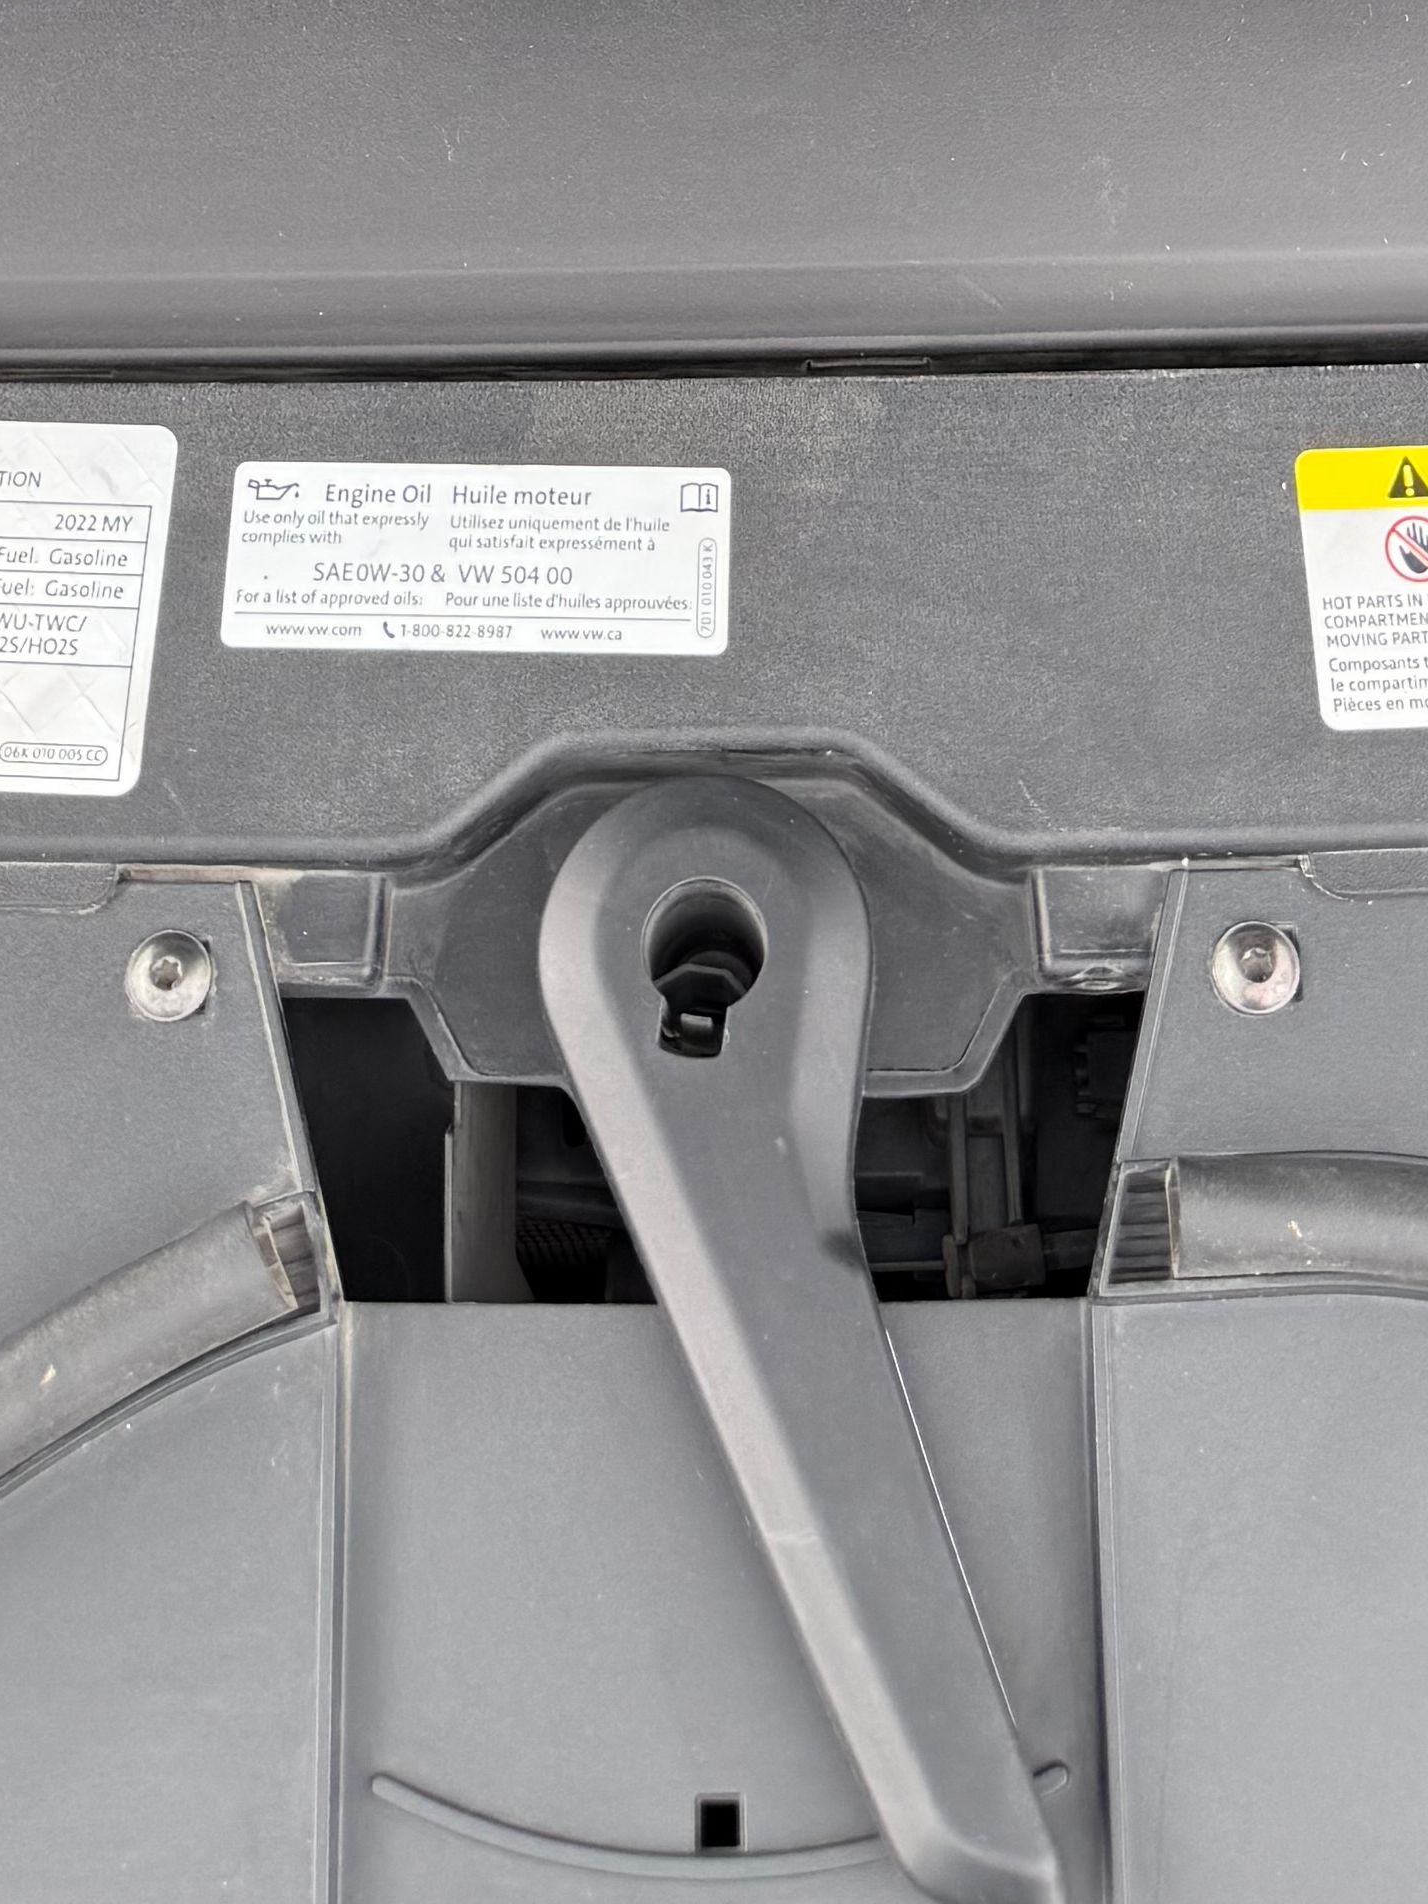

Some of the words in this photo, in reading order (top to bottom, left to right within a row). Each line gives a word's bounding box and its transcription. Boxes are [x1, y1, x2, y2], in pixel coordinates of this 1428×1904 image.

[325, 484, 396, 509] Engine
[402, 484, 431, 504] Oil
[453, 485, 507, 505] Huile
[514, 488, 592, 506] moteur
[54, 514, 96, 532] 2022
[102, 516, 133, 532] MY
[244, 510, 270, 524] Use
[273, 511, 304, 528] only
[308, 511, 325, 525] oil
[329, 512, 358, 525] that
[362, 512, 429, 530] expressly
[450, 515, 504, 529] Utilisez
[509, 517, 599, 533] uniquement
[604, 518, 621, 531] de
[625, 519, 670, 532] l'huile
[241, 530, 305, 546] complies
[309, 530, 342, 544] with
[449, 536, 472, 552] qui
[476, 537, 534, 549] satisfait
[539, 537, 641, 553] expressément
[50, 548, 128, 567] Gasoline
[430, 565, 446, 583] &
[458, 564, 494, 584] VW
[501, 566, 539, 584] 504
[546, 567, 573, 585] 00
[45, 580, 124, 599] Gasoline
[236, 589, 260, 604] For
[276, 590, 297, 604] list
[301, 589, 316, 604] of
[321, 591, 389, 609] approved
[393, 591, 423, 606] oils:
[445, 592, 477, 607] Pour
[482, 596, 509, 607] une
[513, 593, 542, 608] liste
[546, 593, 601, 609] d'huiles
[604, 595, 692, 612] approuvées:
[1323, 596, 1352, 611] HOT
[1357, 594, 1403, 609] PARTS
[1408, 593, 1423, 607] IN
[266, 624, 362, 637] www.vw.com
[400, 624, 513, 639] 1-800-822-8987
[541, 627, 622, 641] www.vw.ca
[1326, 632, 1388, 648] MOVING
[1329, 656, 1420, 674] Composants
[1333, 695, 1381, 713] Pièces
[1386, 697, 1404, 710] en
